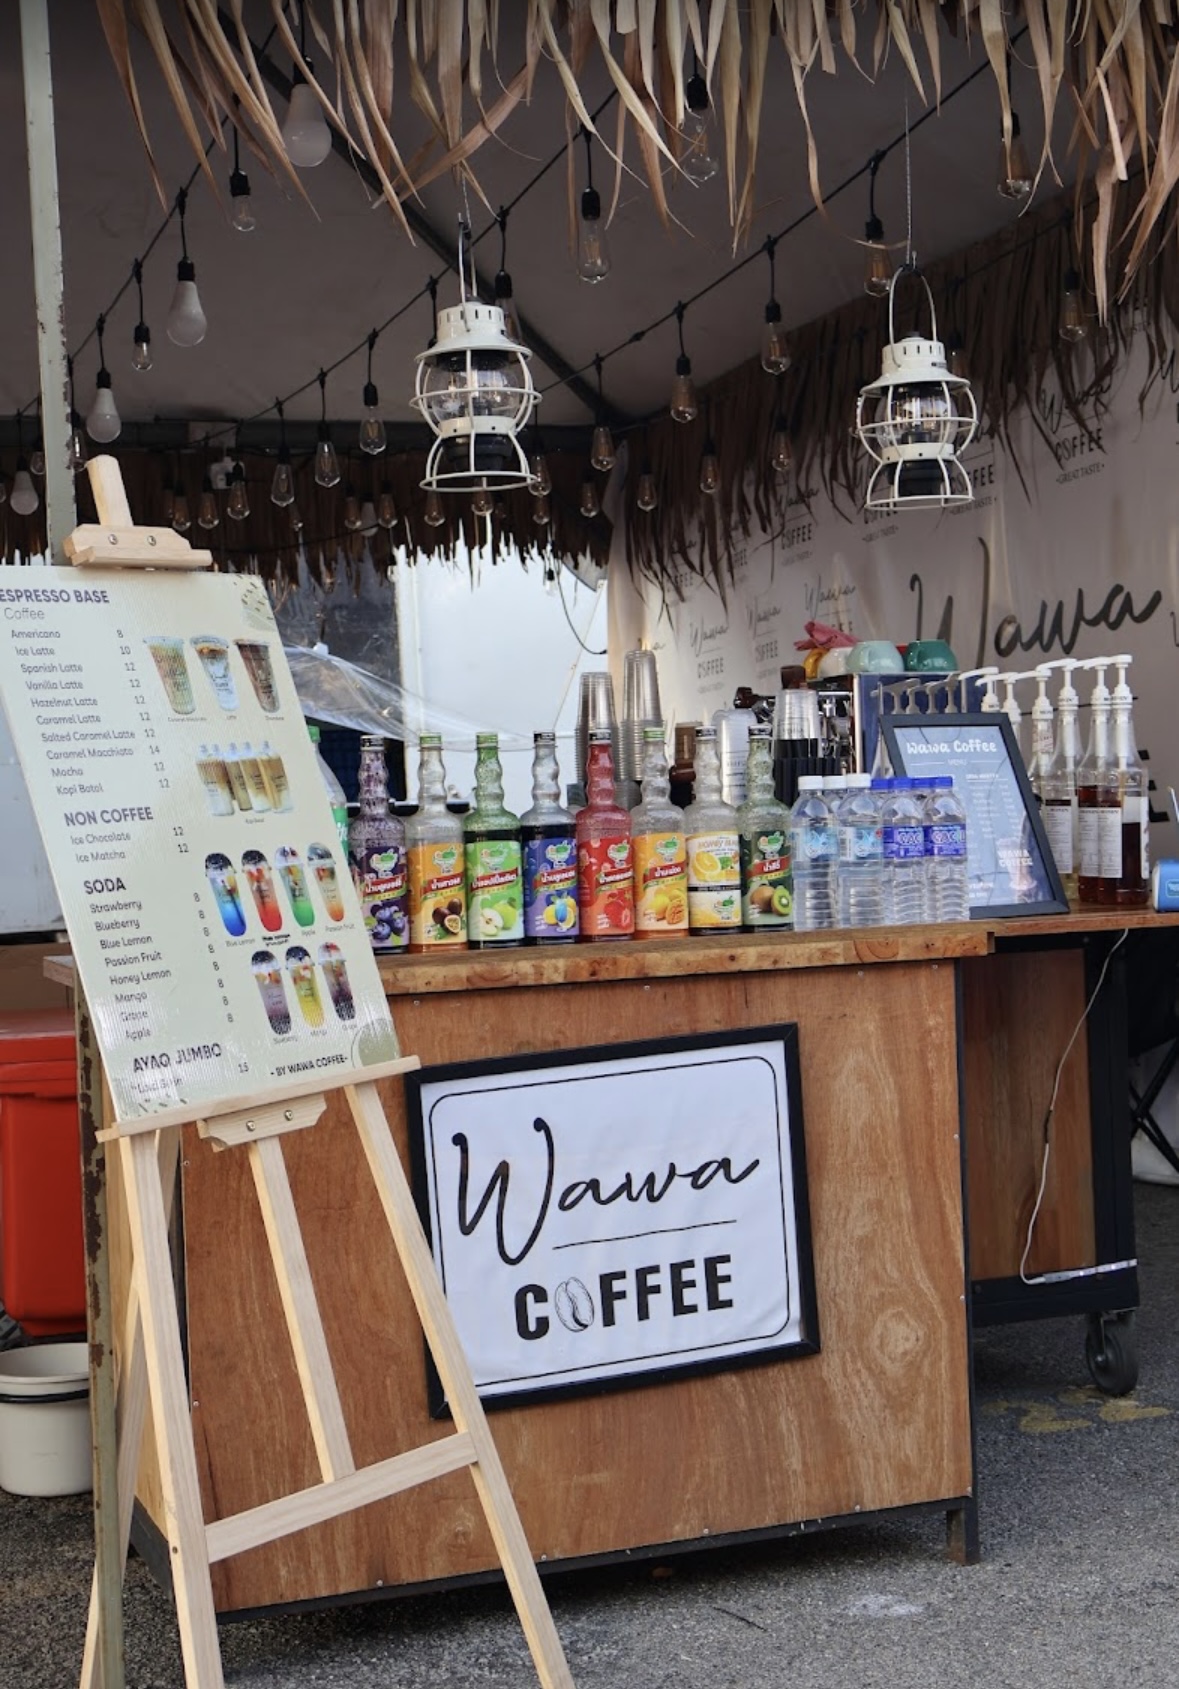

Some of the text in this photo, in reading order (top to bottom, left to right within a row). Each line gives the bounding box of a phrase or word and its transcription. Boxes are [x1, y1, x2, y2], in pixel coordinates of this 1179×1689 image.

[0, 588, 110, 604] ESPRESSO BASE
[909, 536, 1163, 668] Wawa
[4, 606, 45, 621] Coffee
[11, 629, 61, 639] Americano
[15, 645, 131, 656] Ice Latte 10
[21, 662, 136, 675] Spanish Latte 12
[25, 679, 141, 690] Vanilla Latte 12
[30, 695, 146, 708] Hazelnut Latte 12
[35, 712, 151, 725] Caramel Latte 12
[41, 728, 156, 743] Salted Caramel Latte 12
[46, 745, 160, 760] Caramel Macchiato 14
[953, 738, 998, 753] Coffee
[154, 762, 165, 772] 12
[159, 778, 170, 789] 12
[64, 806, 154, 827] NON COFFEE
[70, 826, 184, 845] Ice Chocolate 12
[75, 843, 189, 863] Ice Matcha 12
[83, 877, 126, 895] SODA
[90, 892, 200, 914] Strawberry 8
[95, 917, 140, 932] Blueberry
[100, 938, 121, 950] Blue
[122, 935, 152, 947] Lemon
[104, 955, 140, 968] Passion
[141, 950, 162, 962] Fruit
[110, 961, 220, 985] Honey Lemon 8
[115, 978, 225, 1003] Mango 8
[175, 1042, 222, 1065] JUMBO
[288, 1060, 316, 1074] WAWA
[451, 1117, 760, 1266] Wawa
[514, 1253, 734, 1341] COFFEE
